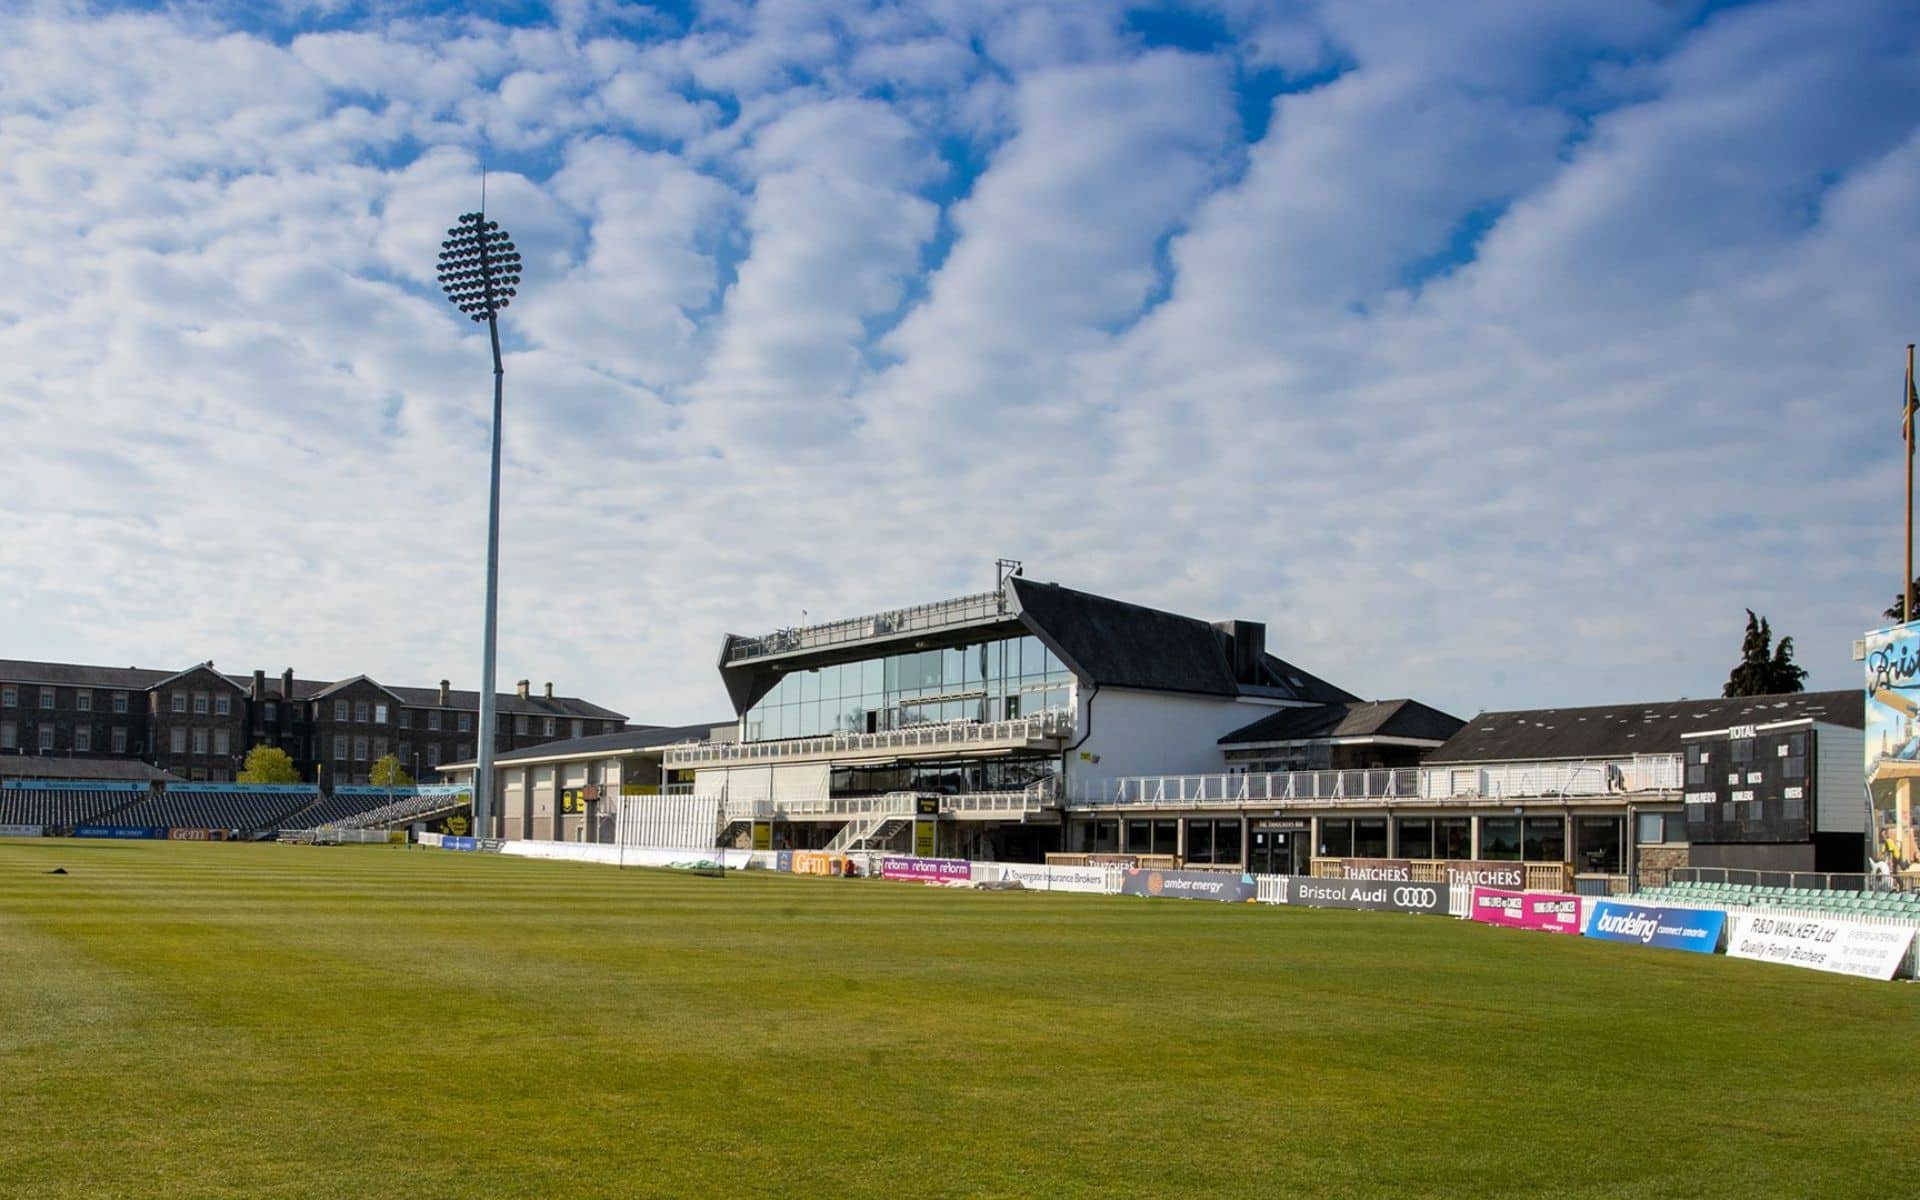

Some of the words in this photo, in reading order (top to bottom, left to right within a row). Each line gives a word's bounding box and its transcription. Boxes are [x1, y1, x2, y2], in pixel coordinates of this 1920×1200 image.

[1728, 725, 1757, 739] TOTAL
[173, 828, 205, 840] Gem
[796, 853, 826, 874] Gem
[1011, 870, 1042, 883] Towergate
[1043, 871, 1074, 883] Insurance
[1074, 873, 1102, 885] Brokers
[1343, 866, 1408, 881] THATCHERS
[1447, 868, 1521, 886] THATCHERS
[1164, 878, 1191, 890] amber
[1192, 880, 1223, 893] energy
[1300, 885, 1346, 900] Bristol
[1350, 888, 1387, 902] Audi
[1657, 926, 1682, 936] connect
[1682, 928, 1708, 938] smarter
[1750, 918, 1775, 935] R&D
[1815, 928, 1838, 943] Ltd
[1741, 939, 1767, 958] Quality
[1767, 943, 1793, 961] Family
